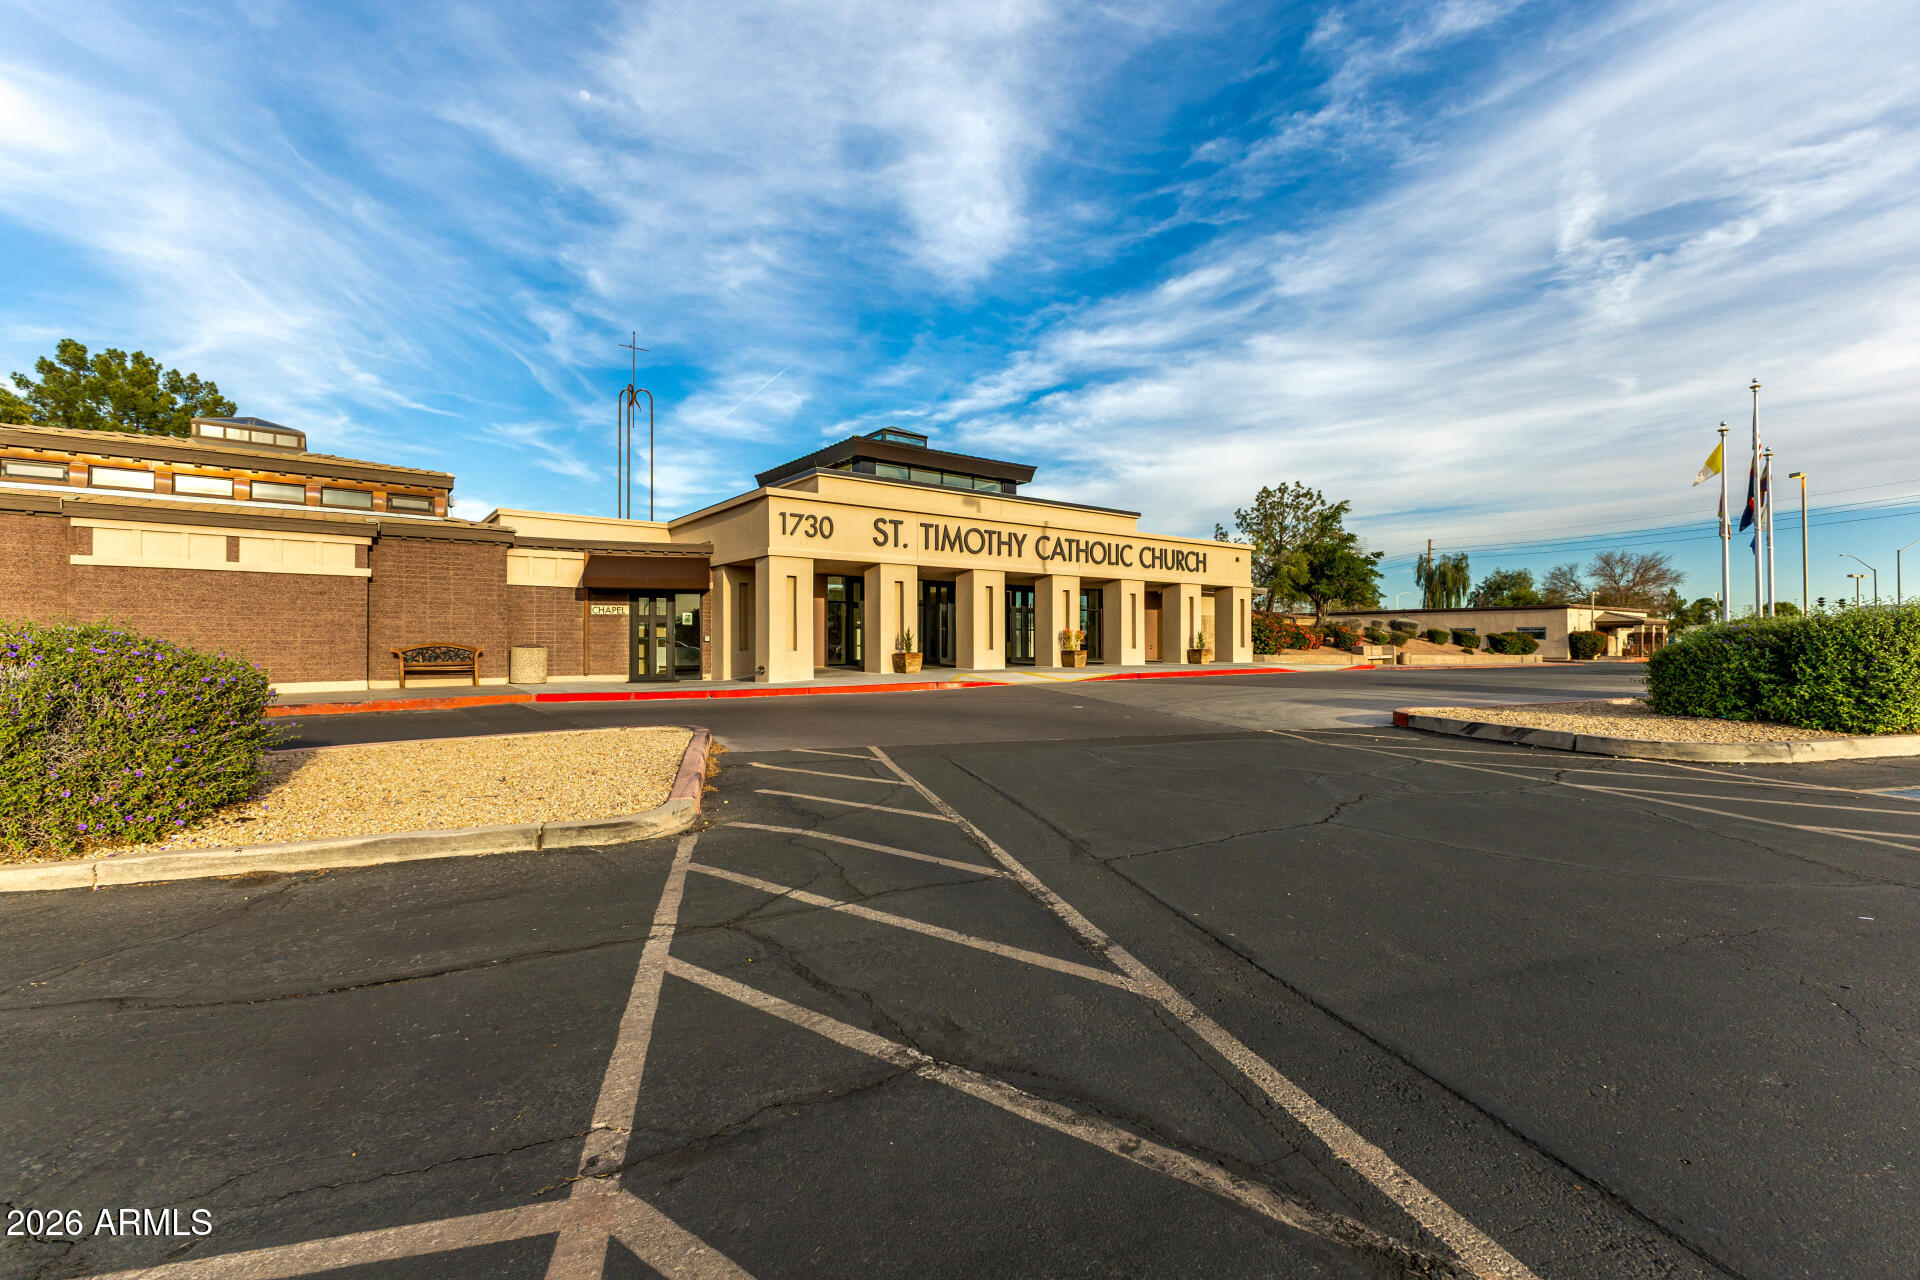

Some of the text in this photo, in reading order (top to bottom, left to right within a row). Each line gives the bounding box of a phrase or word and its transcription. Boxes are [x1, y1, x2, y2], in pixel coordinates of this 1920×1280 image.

[779, 511, 834, 539] 1730
[873, 517, 1207, 573] ST. TIMOTHY CATHOLIC CHURCH
[592, 606, 625, 614] CHAPEL
